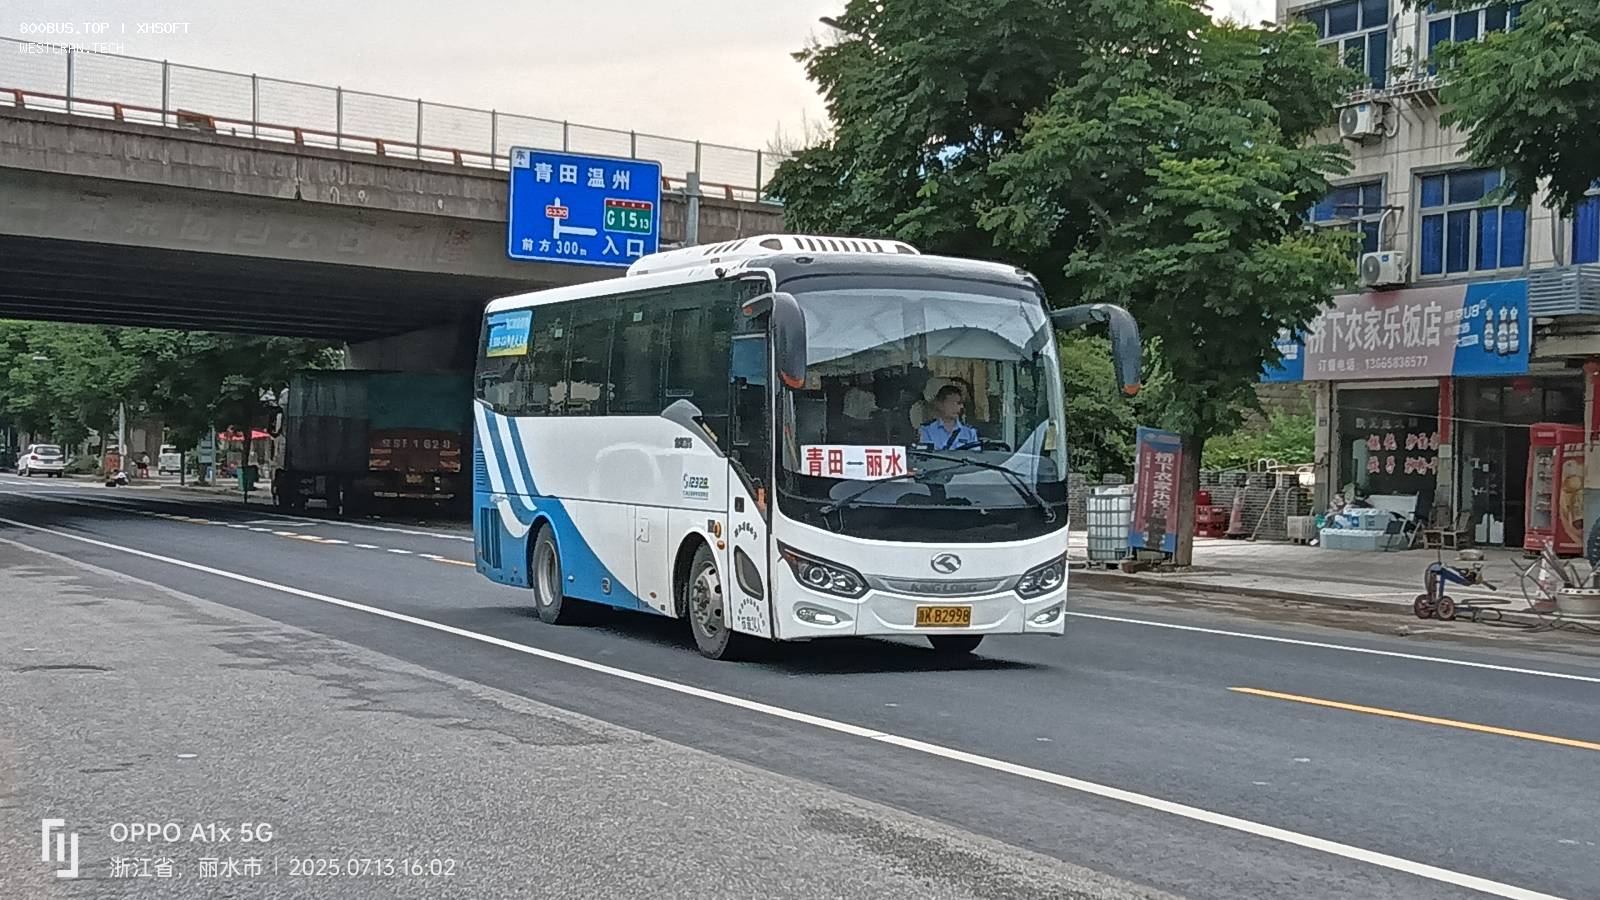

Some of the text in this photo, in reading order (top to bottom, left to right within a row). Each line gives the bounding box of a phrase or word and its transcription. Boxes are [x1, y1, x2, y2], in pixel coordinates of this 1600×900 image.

[534, 162, 631, 191] 青田 温州
[602, 235, 645, 258] 入口
[806, 447, 903, 477] 青田 丽水
